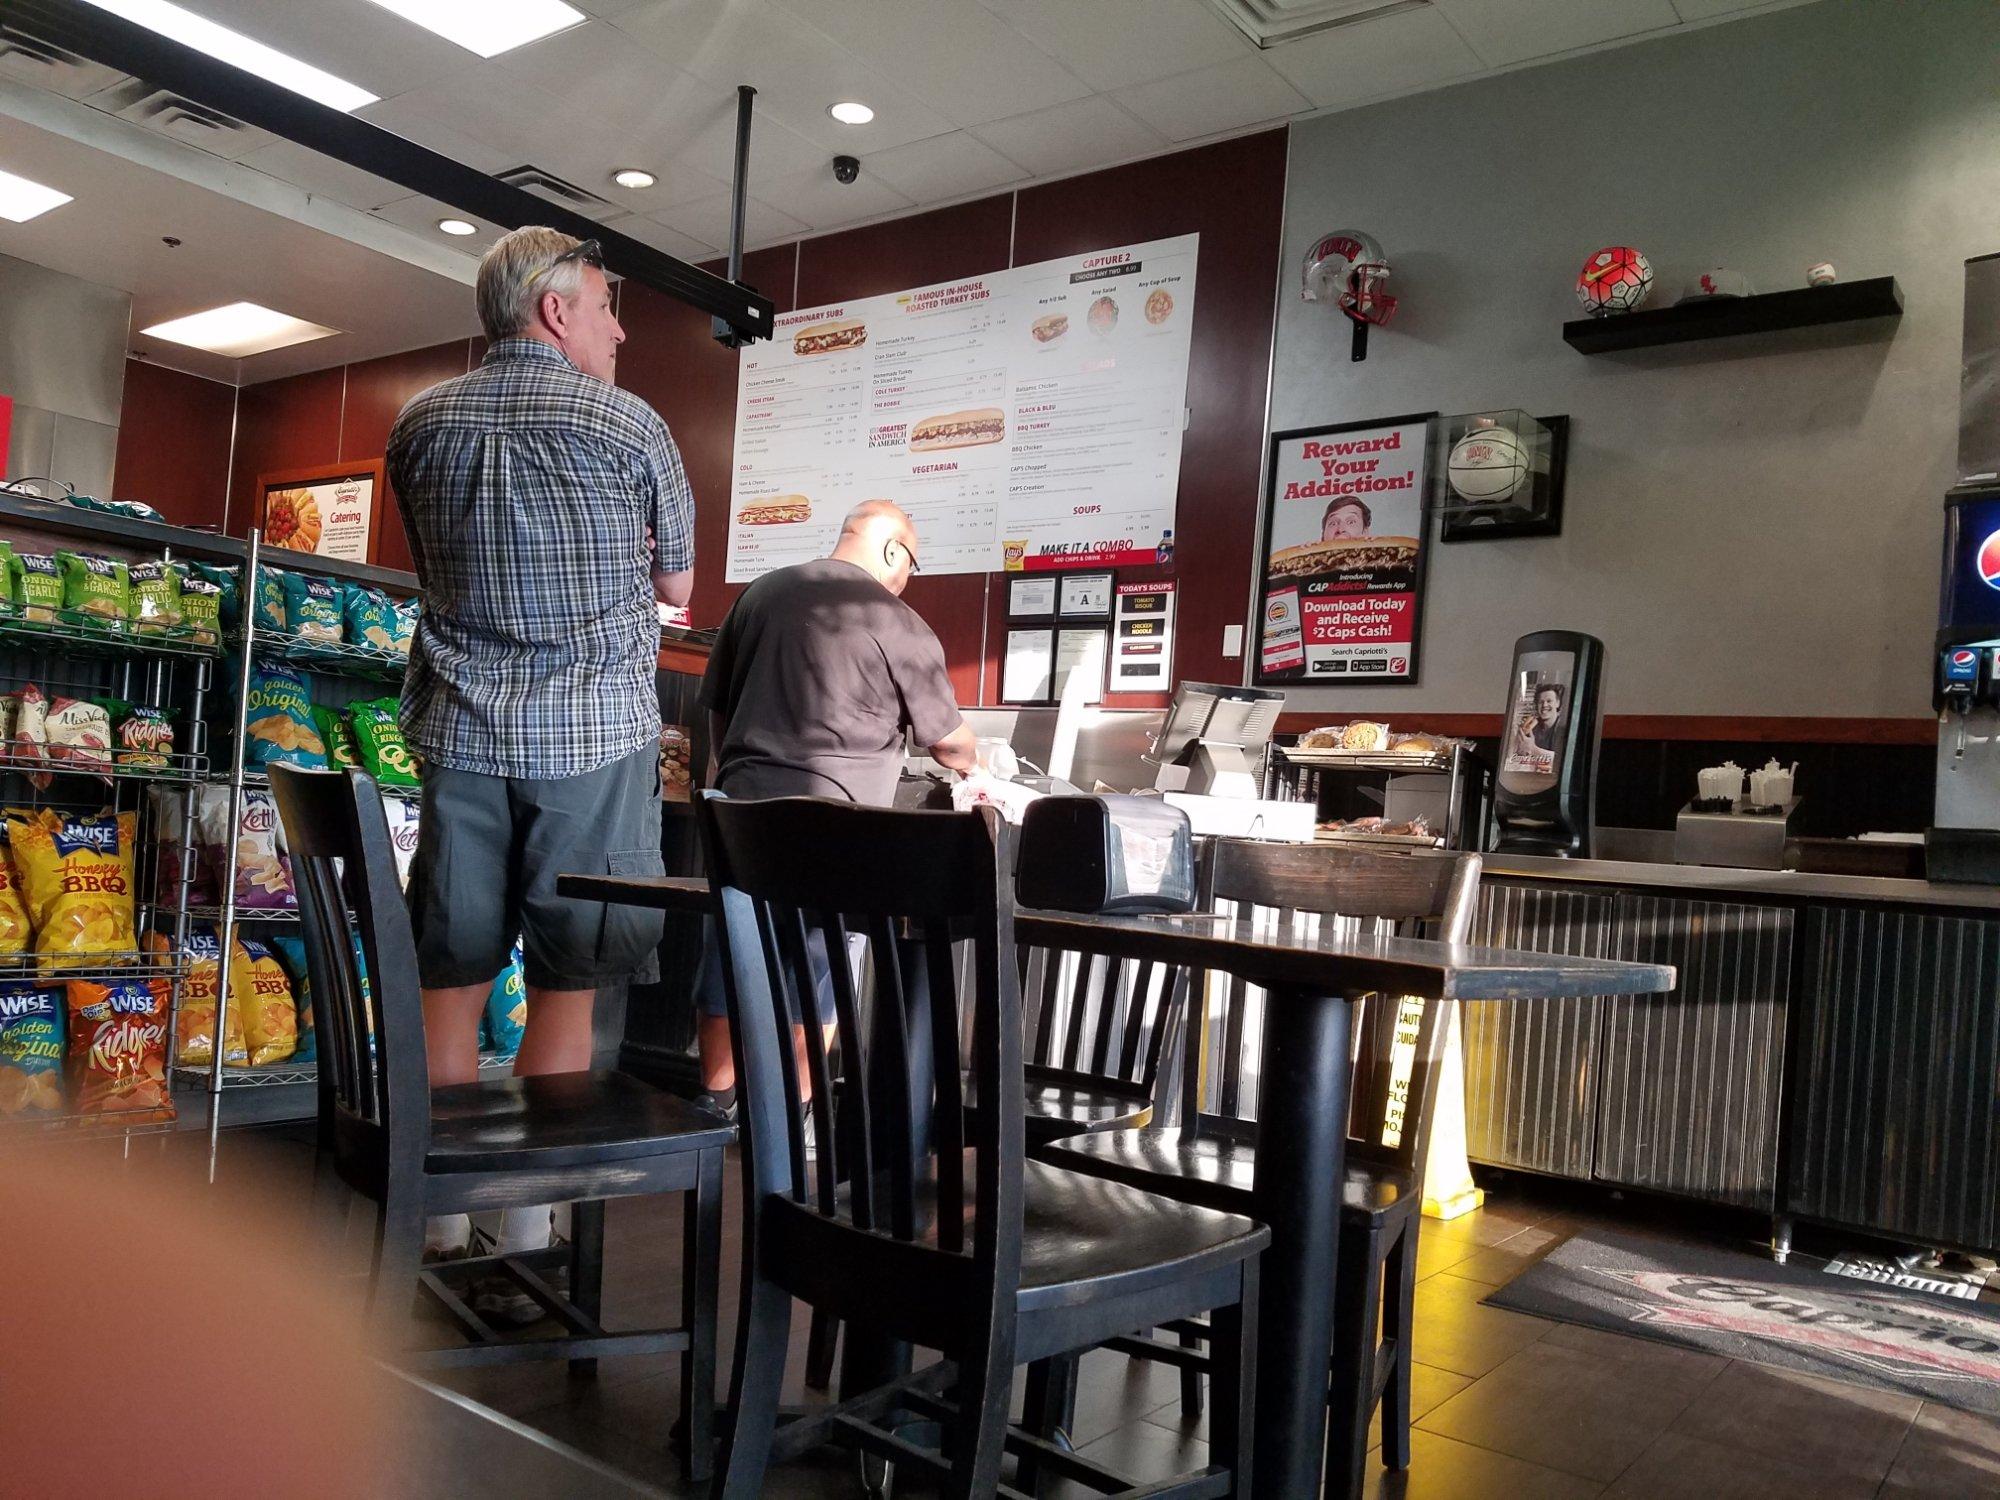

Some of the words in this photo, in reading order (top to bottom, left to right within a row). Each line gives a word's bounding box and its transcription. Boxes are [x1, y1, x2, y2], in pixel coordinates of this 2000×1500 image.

[1082, 253, 1124, 269] CAPTURE
[1126, 253, 1131, 262] 2
[1074, 272, 1096, 282] CHOOSE
[1096, 270, 1107, 278] ANY
[914, 290, 945, 302] FAMOUS
[946, 282, 983, 296] IN-HOUSE
[906, 300, 938, 313] ROASTED
[940, 294, 970, 306] TURKEY
[970, 290, 990, 300] SUBS
[773, 314, 824, 328] XTRAORDINARY
[826, 308, 844, 318] SUBS
[868, 430, 907, 440] SANDWICH
[878, 424, 908, 432] GREATEST
[876, 438, 906, 447] AMERICA
[1302, 432, 1401, 460] Reward
[912, 462, 958, 474] VEGETARIAN
[1024, 464, 1046, 472] Chopped
[1321, 458, 1380, 476] Your
[1284, 470, 1414, 500] Addiction!
[1072, 504, 1102, 515] SOUPS
[330, 510, 361, 524] Catering
[1040, 543, 1068, 556] MAKE
[1071, 542, 1082, 554] IT
[1082, 542, 1090, 552] A
[1093, 540, 1134, 552] COMBO
[24, 556, 54, 570] WISE
[84, 558, 114, 572] WISE
[129, 568, 160, 579] WISE
[1339, 572, 1374, 581] Introducing
[22, 575, 62, 588] ONION
[1120, 584, 1148, 593] TODAY'S
[1149, 583, 1173, 591] SOUPS
[1393, 582, 1406, 590] App
[128, 584, 170, 596] ONION
[307, 583, 334, 597] WISE
[180, 598, 218, 608] NION
[1080, 594, 1090, 605] A
[1304, 600, 1366, 612] Download
[1368, 598, 1406, 612] Today
[1317, 612, 1340, 625] and
[1342, 612, 1390, 624] Receive
[1312, 627, 1325, 638] $2
[1326, 626, 1356, 640] Caps
[1358, 624, 1392, 637] Cash!
[1354, 648, 1388, 656] Capriotti's
[258, 658, 295, 676] WISE
[264, 680, 306, 694] golden
[248, 690, 312, 718] Original
[59, 712, 88, 726] Miss
[134, 708, 162, 718] WISE
[117, 716, 174, 750] Ridgies
[372, 724, 400, 735] ONIO
[239, 807, 276, 836] Kettl
[62, 824, 115, 844] WISE
[60, 876, 128, 896] BBQ
[188, 969, 217, 981] one
[246, 964, 284, 980] Hone
[0, 994, 54, 1016] WISE
[110, 994, 156, 1014] WISE
[2, 1021, 55, 1042] golden
